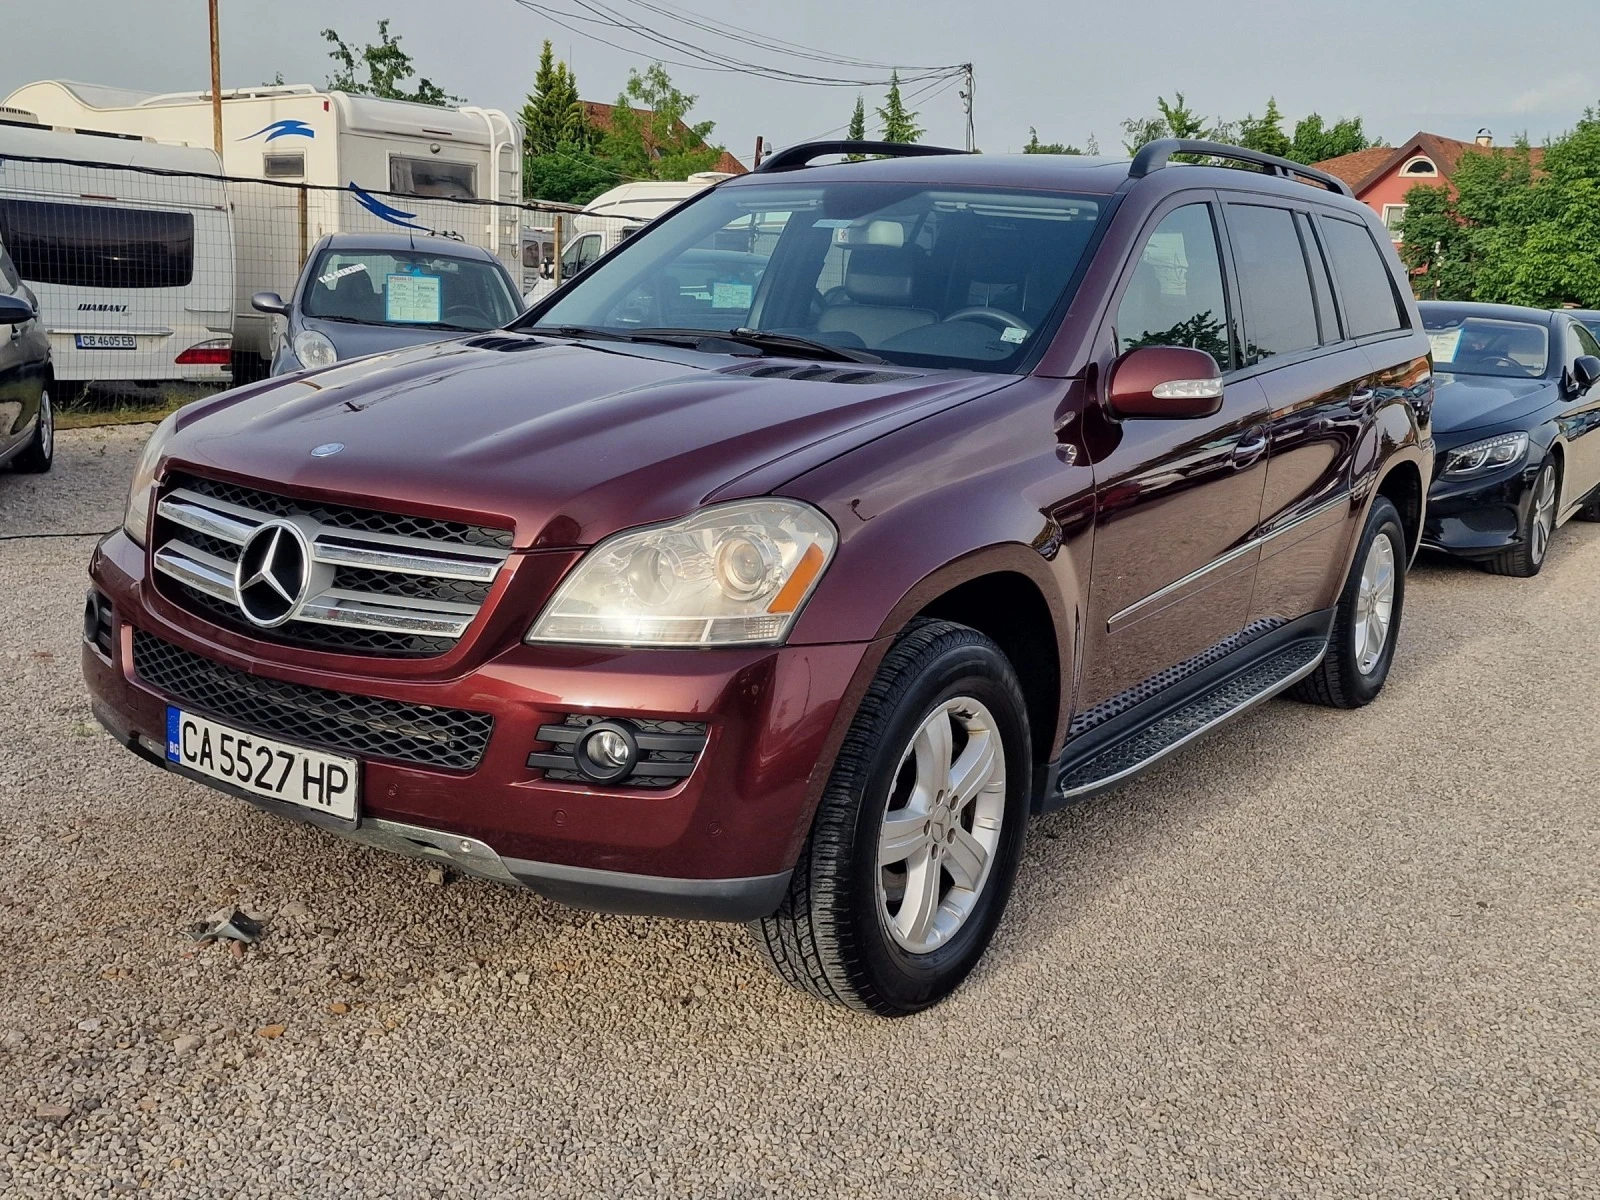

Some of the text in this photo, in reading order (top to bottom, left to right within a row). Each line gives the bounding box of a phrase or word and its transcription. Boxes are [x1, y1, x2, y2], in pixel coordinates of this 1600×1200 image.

[77, 303, 129, 312] DIAMANT
[83, 335, 96, 346] CB
[97, 336, 121, 346] 4605
[121, 336, 135, 347] EB
[169, 741, 180, 756] BG
[182, 720, 349, 807] CA 5527 HP
